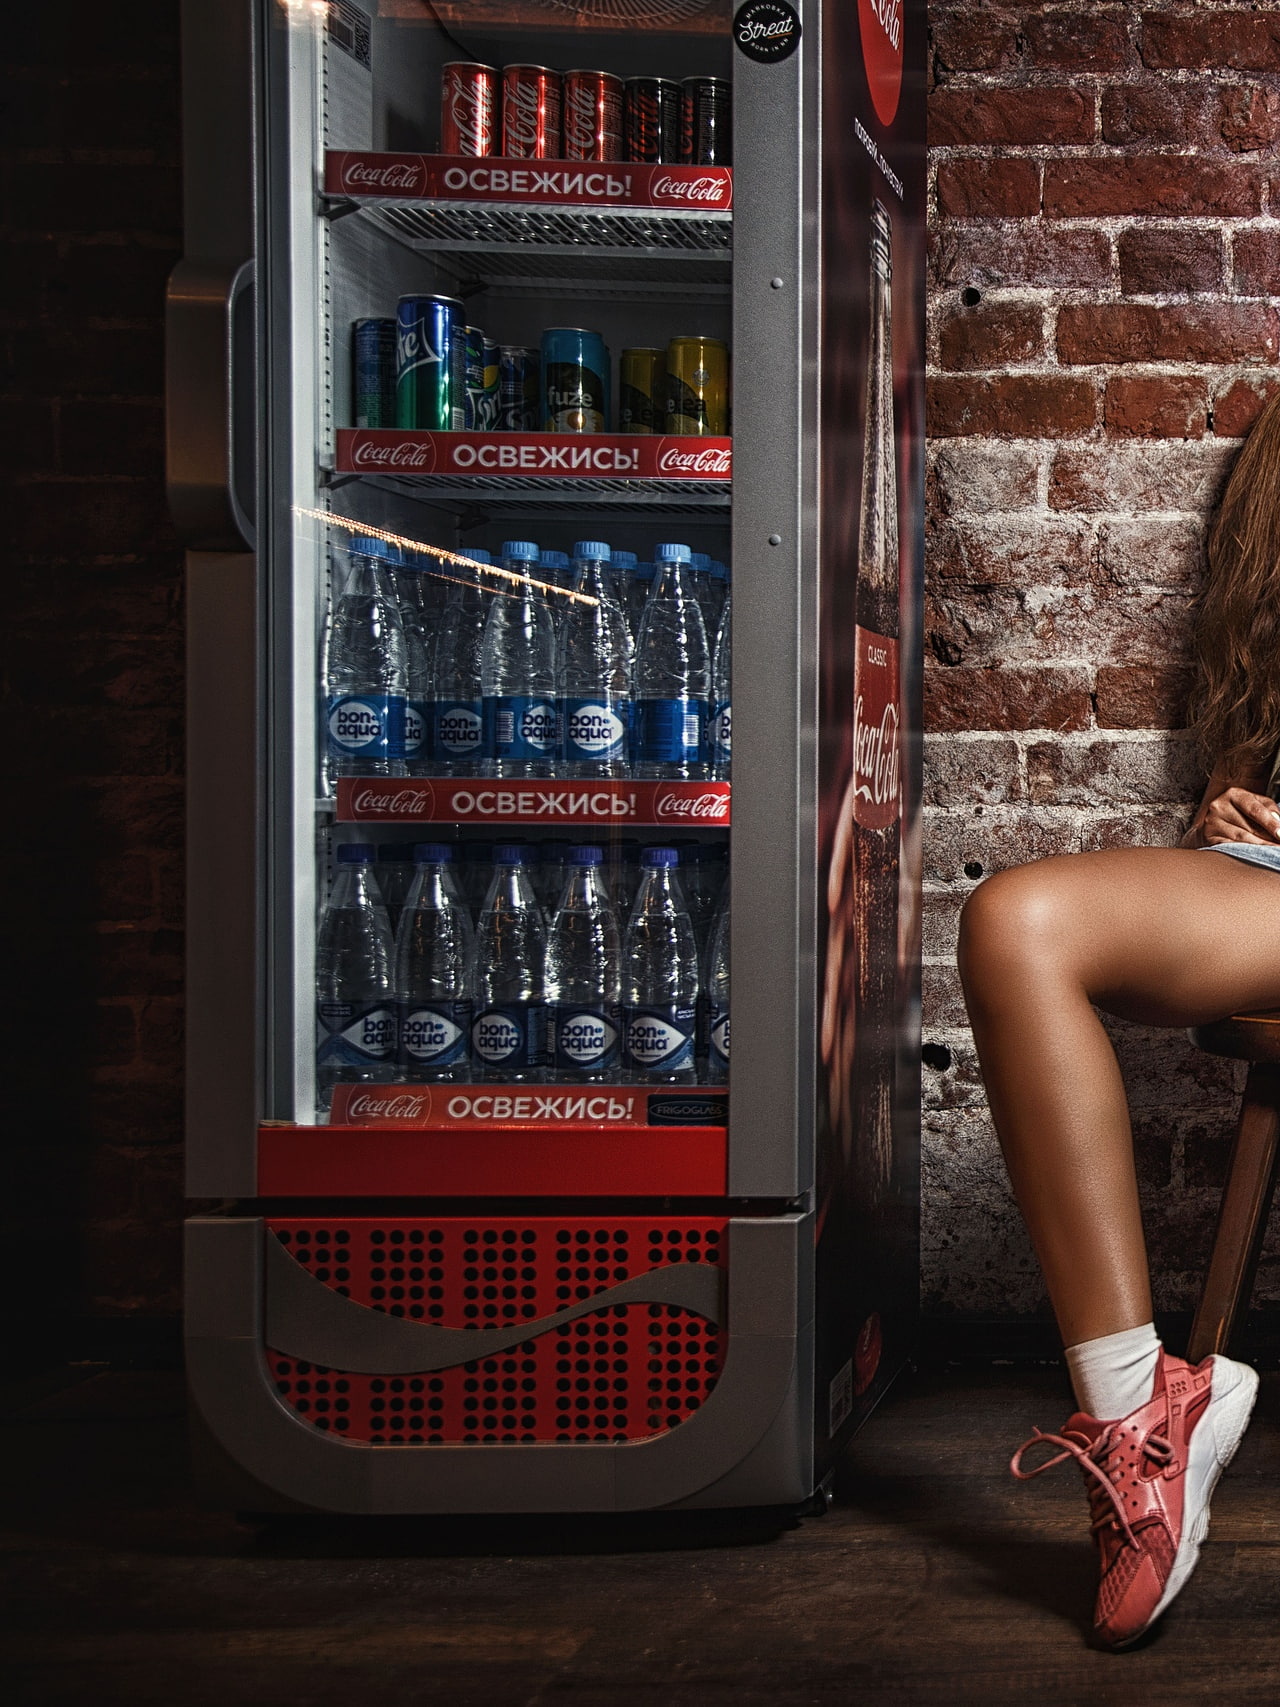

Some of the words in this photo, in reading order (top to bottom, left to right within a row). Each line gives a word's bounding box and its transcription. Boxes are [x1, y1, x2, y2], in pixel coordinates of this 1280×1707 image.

[739, 15, 794, 42] Streat
[345, 162, 423, 188] Coca-Cola
[444, 167, 632, 197] ОСВЕЖИСЬ!
[652, 175, 728, 201] Coca-Cola
[548, 385, 593, 408] fuze
[355, 441, 431, 466] Coca-Cola
[453, 444, 639, 470] ОСВЕЖИСЬ!
[660, 448, 731, 473] Coca-Cola
[867, 645, 887, 667] CLASSIC
[337, 724, 382, 739] aqua
[569, 728, 612, 742] aqua
[854, 695, 900, 804] Coca-Cola
[354, 788, 431, 814] Coca-Cola
[451, 791, 637, 816] ОСВЕЖИСЬ!
[657, 792, 731, 818] Coca-Cola
[479, 1036, 521, 1051] aqua
[560, 1037, 605, 1052] aqua
[350, 1094, 428, 1119] Coca-Cola
[447, 1096, 634, 1120] ОСВЕЖИСЬ!
[657, 1105, 722, 1115] FRIGOGLASS
